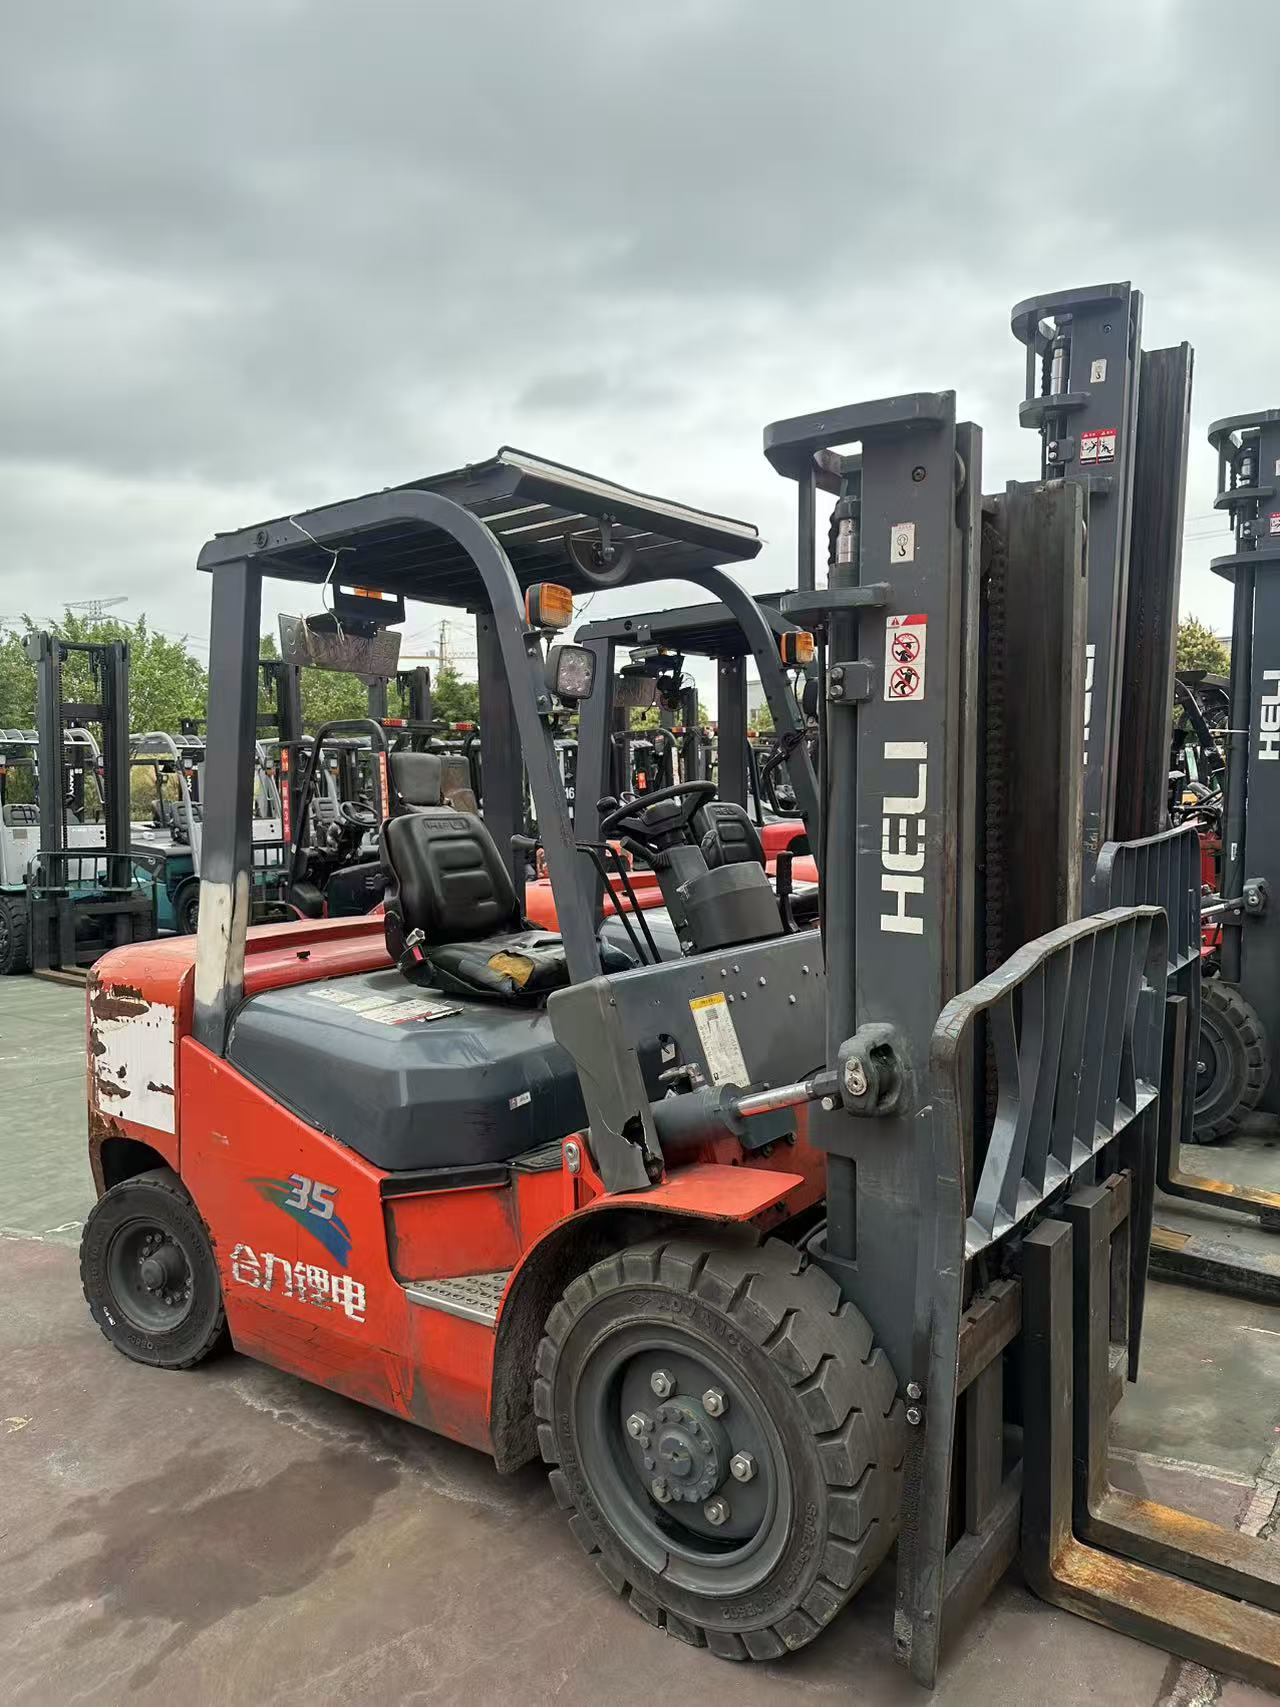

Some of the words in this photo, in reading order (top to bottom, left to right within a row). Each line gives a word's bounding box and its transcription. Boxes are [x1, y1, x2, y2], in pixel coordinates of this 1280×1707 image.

[881, 742, 928, 935] HELI
[285, 1173, 339, 1220] 35
[229, 1243, 367, 1323] 合力锂电
